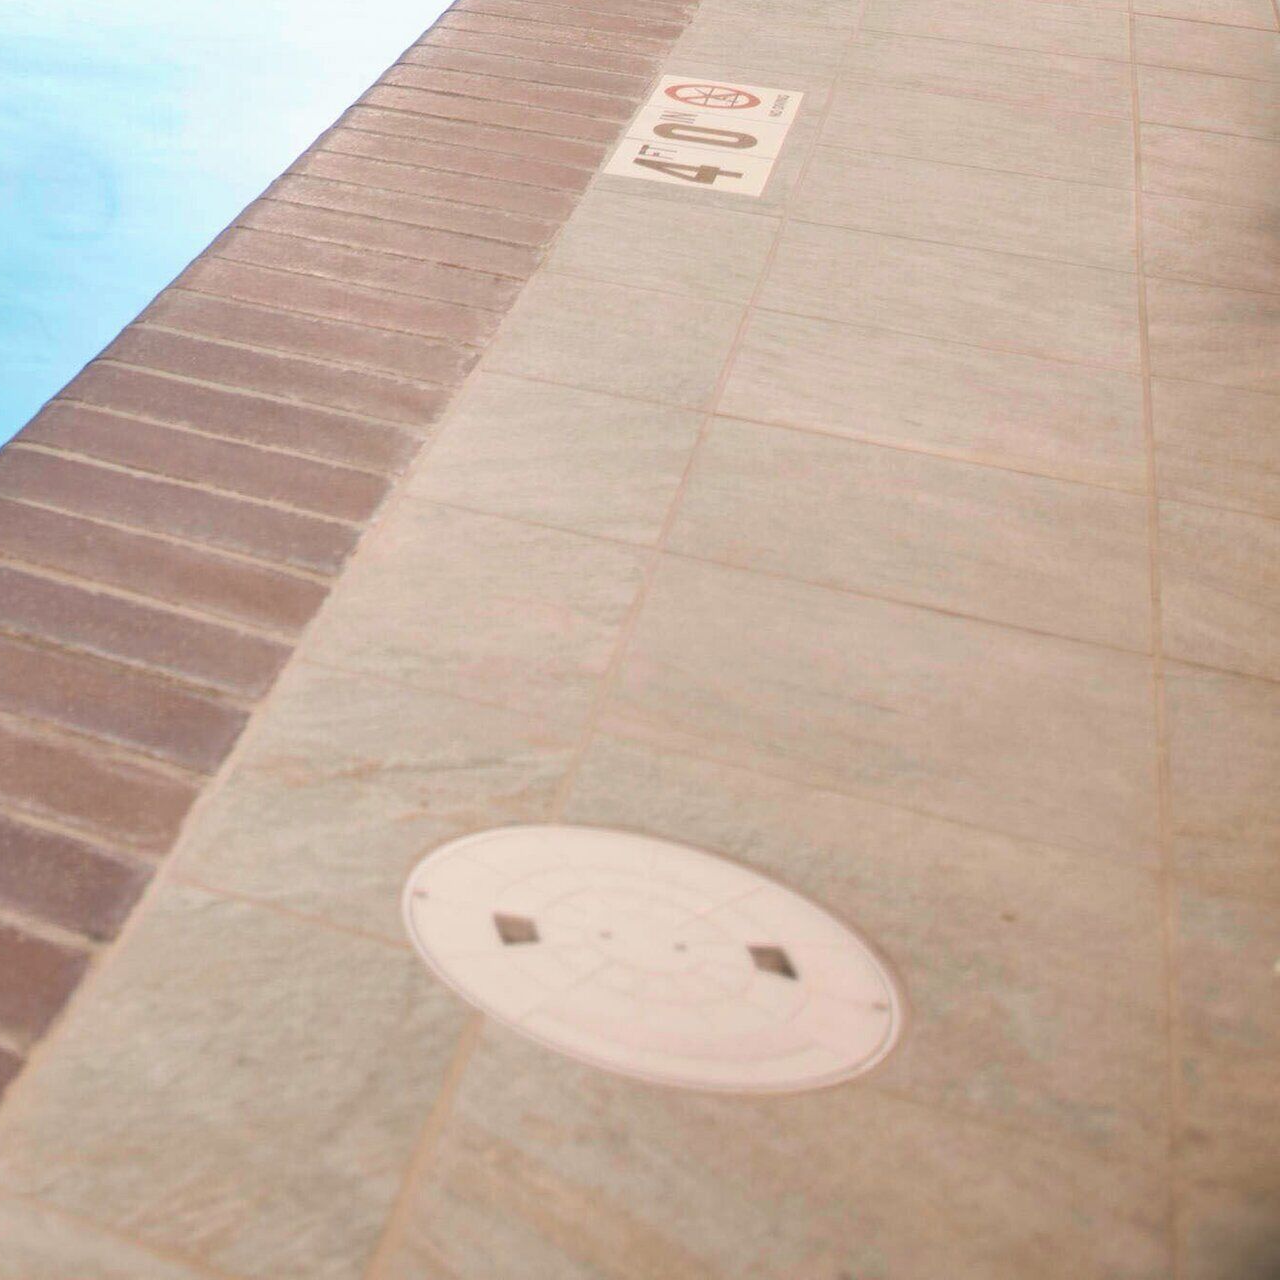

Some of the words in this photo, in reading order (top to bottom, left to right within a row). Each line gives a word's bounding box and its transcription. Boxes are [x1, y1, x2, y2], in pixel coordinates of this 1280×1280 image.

[659, 109, 699, 124] IN
[653, 122, 759, 150] 0
[639, 144, 677, 160] FT
[632, 157, 744, 185] 4
